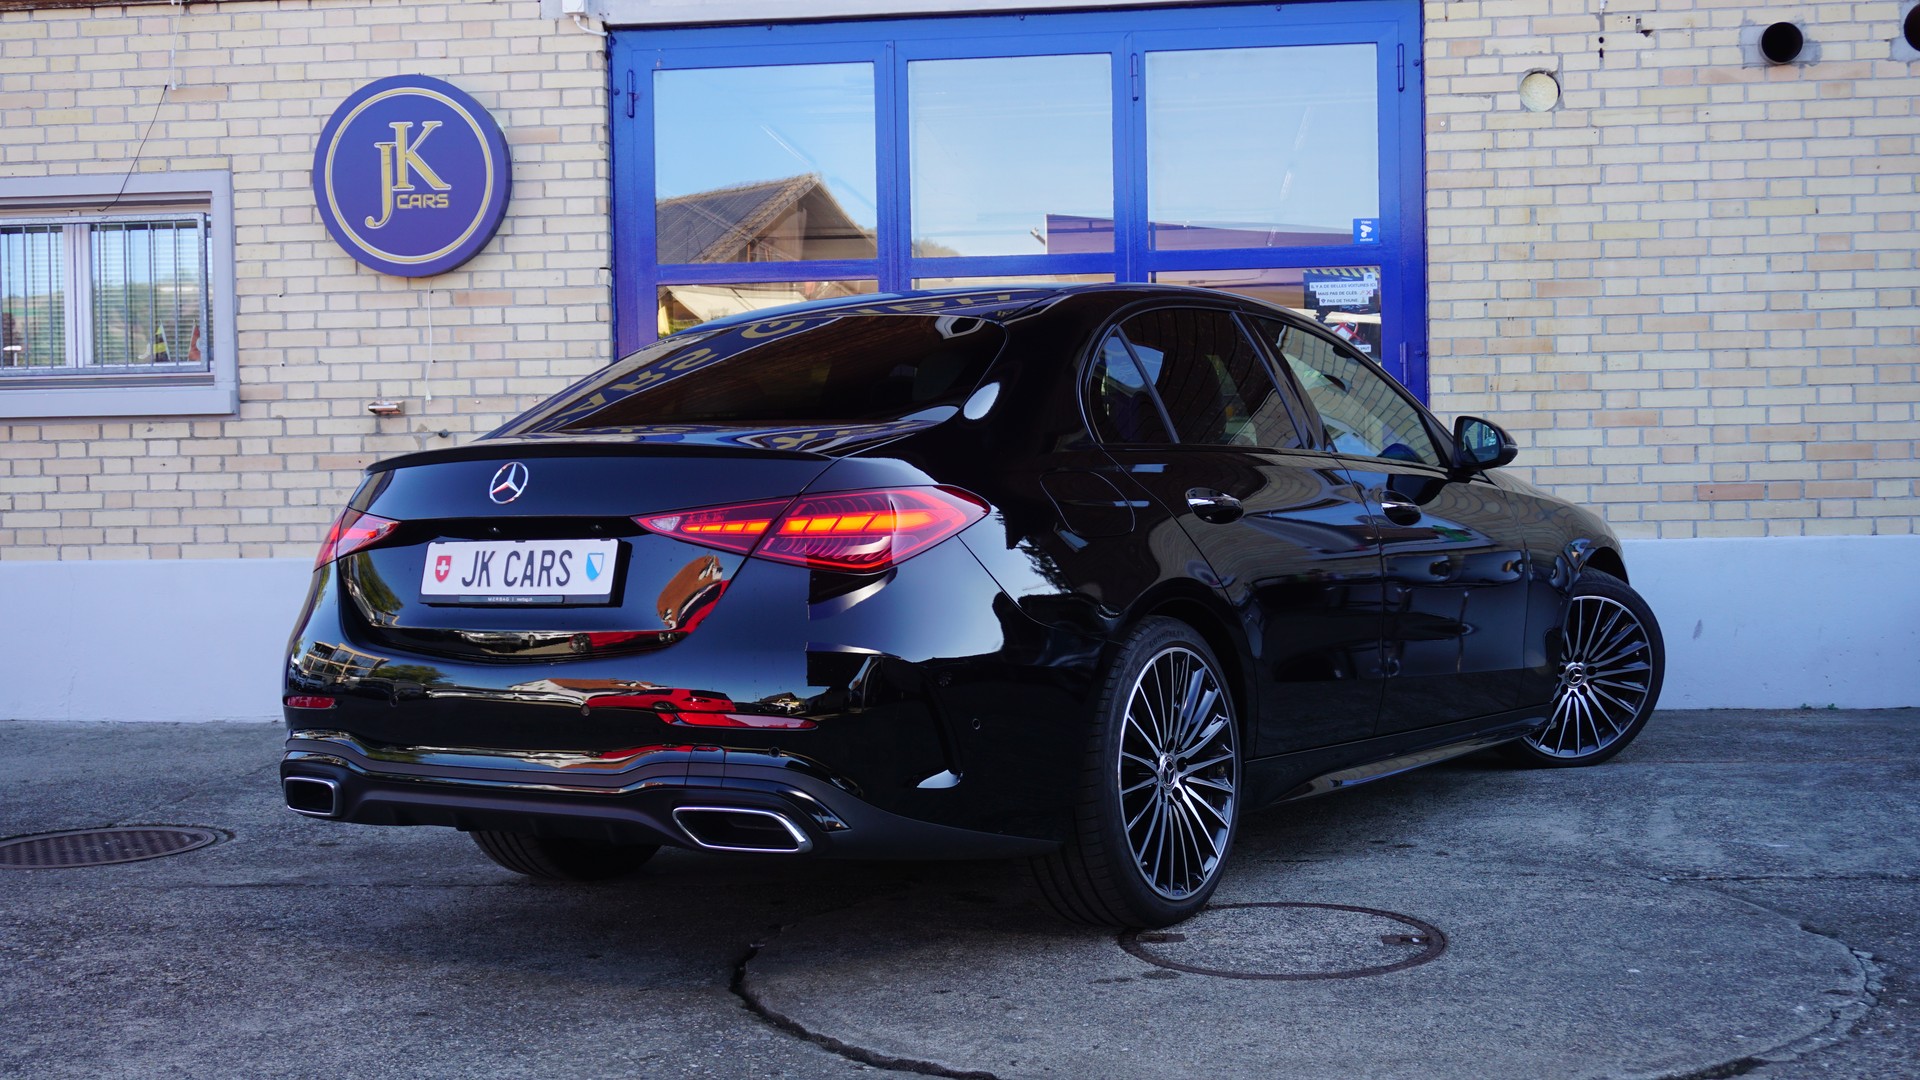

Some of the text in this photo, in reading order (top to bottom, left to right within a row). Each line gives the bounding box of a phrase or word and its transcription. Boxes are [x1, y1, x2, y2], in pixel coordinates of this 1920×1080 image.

[365, 120, 452, 229] JK
[396, 193, 450, 210] CARS
[461, 550, 573, 588] JK CARS
